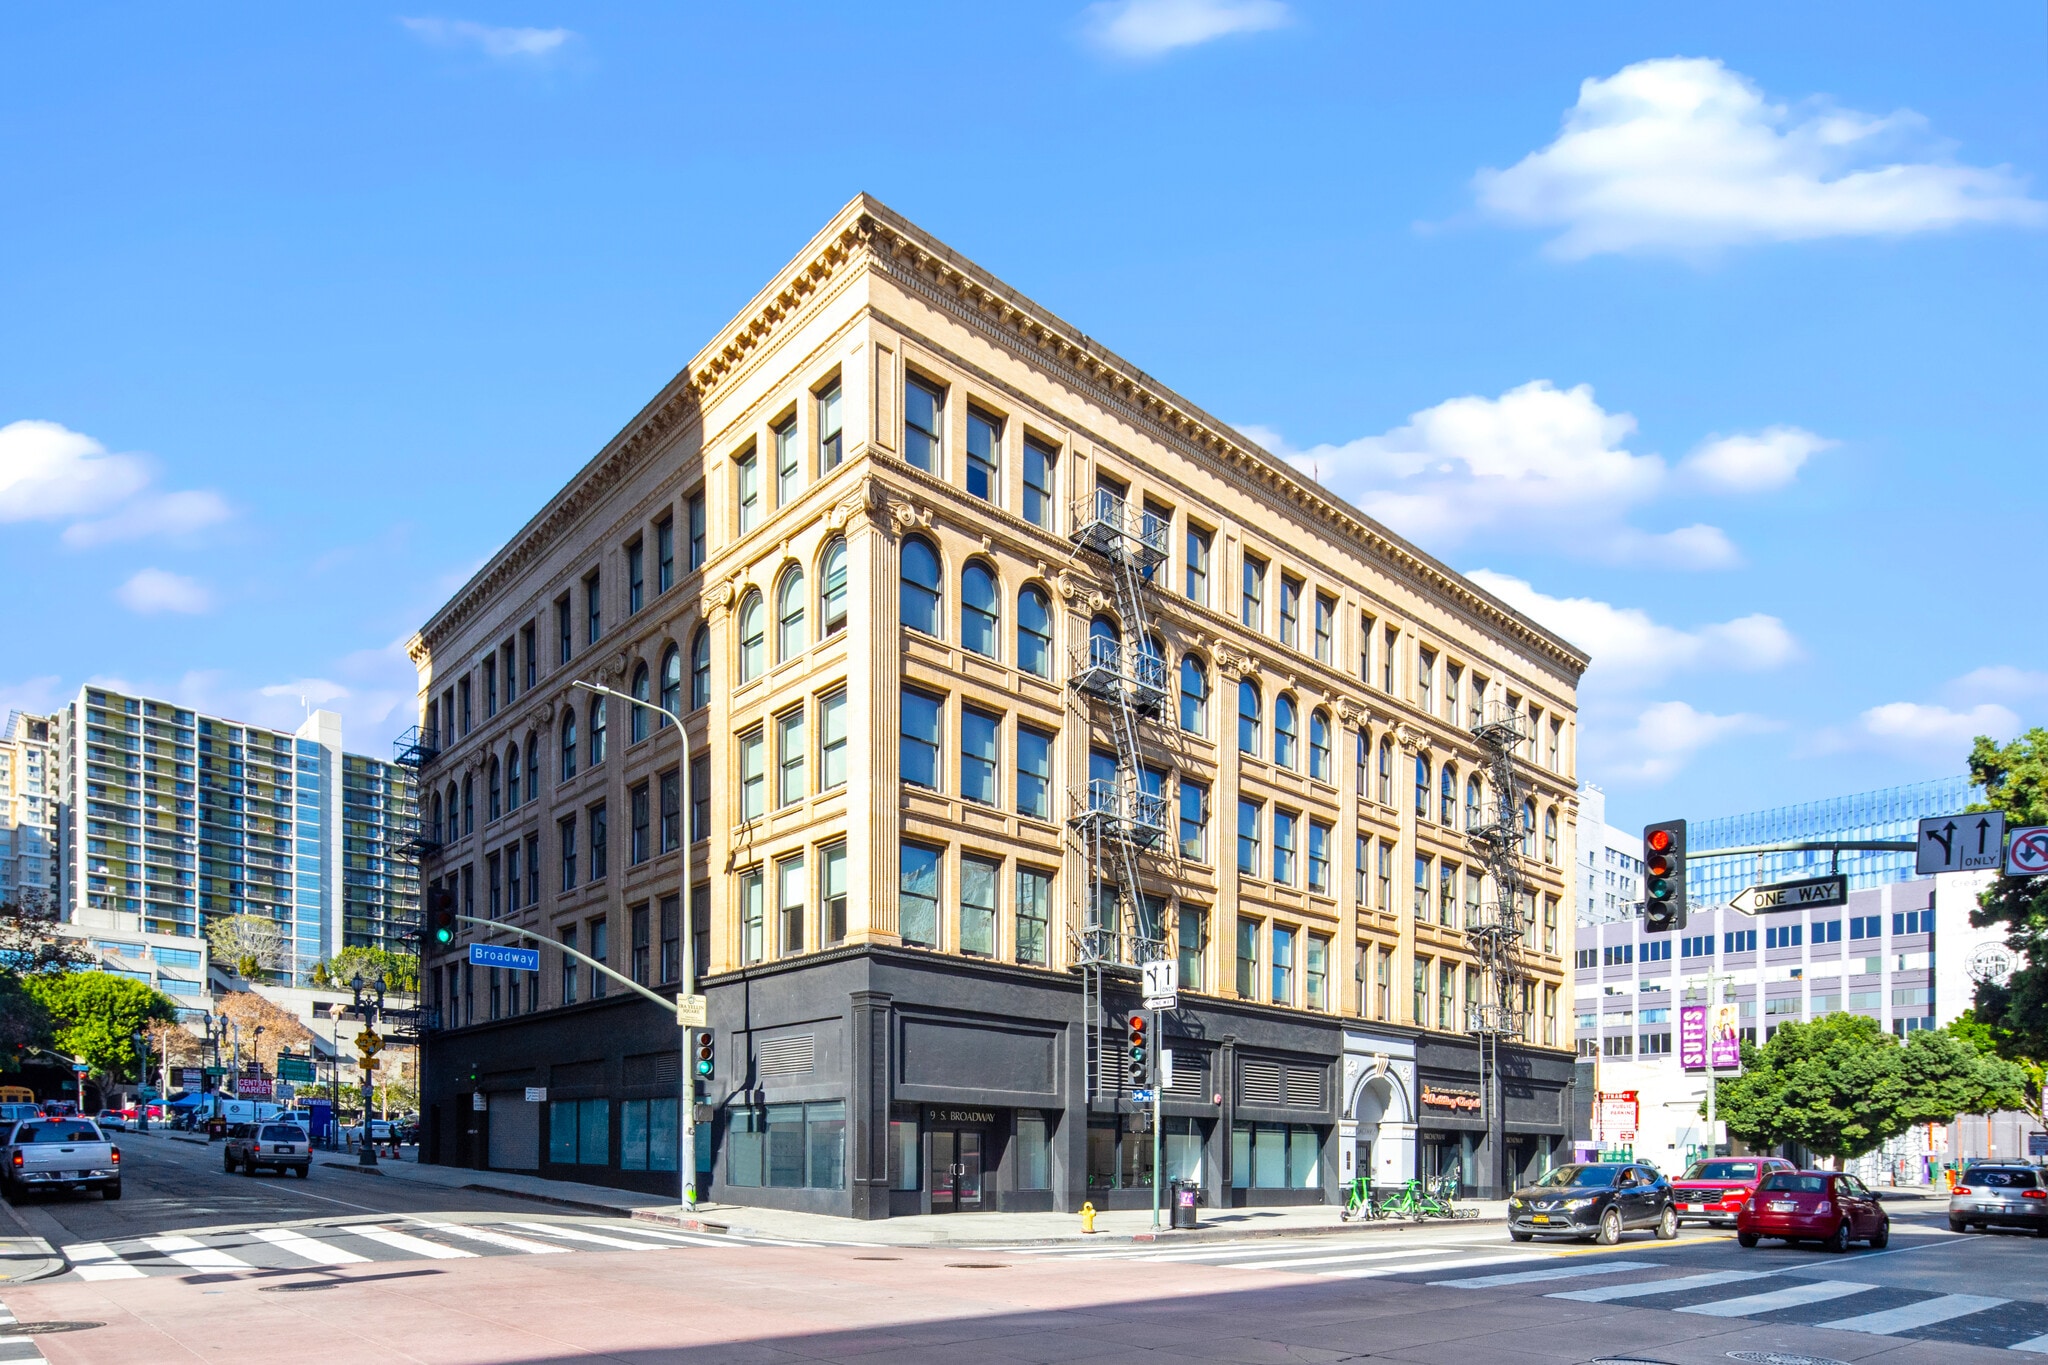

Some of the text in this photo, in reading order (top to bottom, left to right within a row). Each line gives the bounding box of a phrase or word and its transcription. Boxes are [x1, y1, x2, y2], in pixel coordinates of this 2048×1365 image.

[1965, 856, 1996, 867] ONLY
[1754, 883, 1835, 907] ONE WAY
[475, 948, 534, 966] Broadway
[1683, 1010, 1703, 1064] SUFFS
[239, 1078, 271, 1086] CENTRAL
[239, 1086, 271, 1094] MARKET
[930, 1110, 936, 1120] 9
[950, 1111, 996, 1122] BROADWAY
